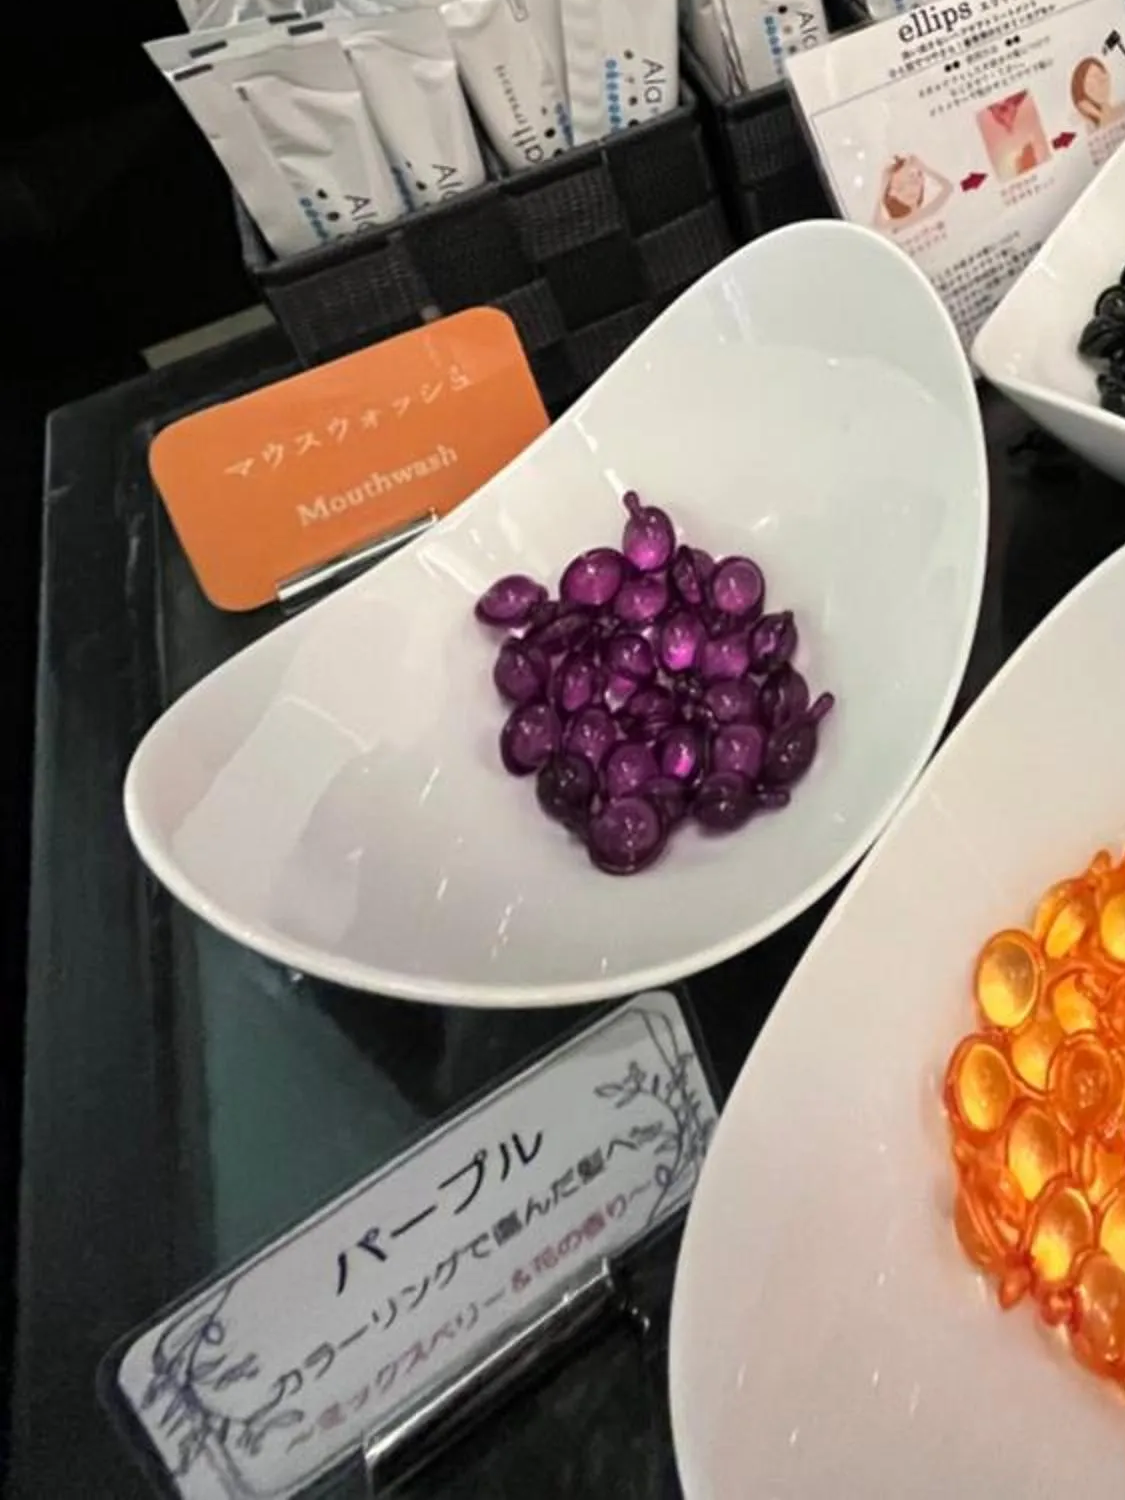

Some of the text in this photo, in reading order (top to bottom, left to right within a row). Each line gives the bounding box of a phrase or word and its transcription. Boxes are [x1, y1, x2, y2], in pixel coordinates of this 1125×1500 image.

[898, 1, 973, 43] ellips
[223, 364, 475, 478] マウスウォッシュ
[296, 444, 459, 528] Mouthwash
[335, 1130, 544, 1295] パープル
